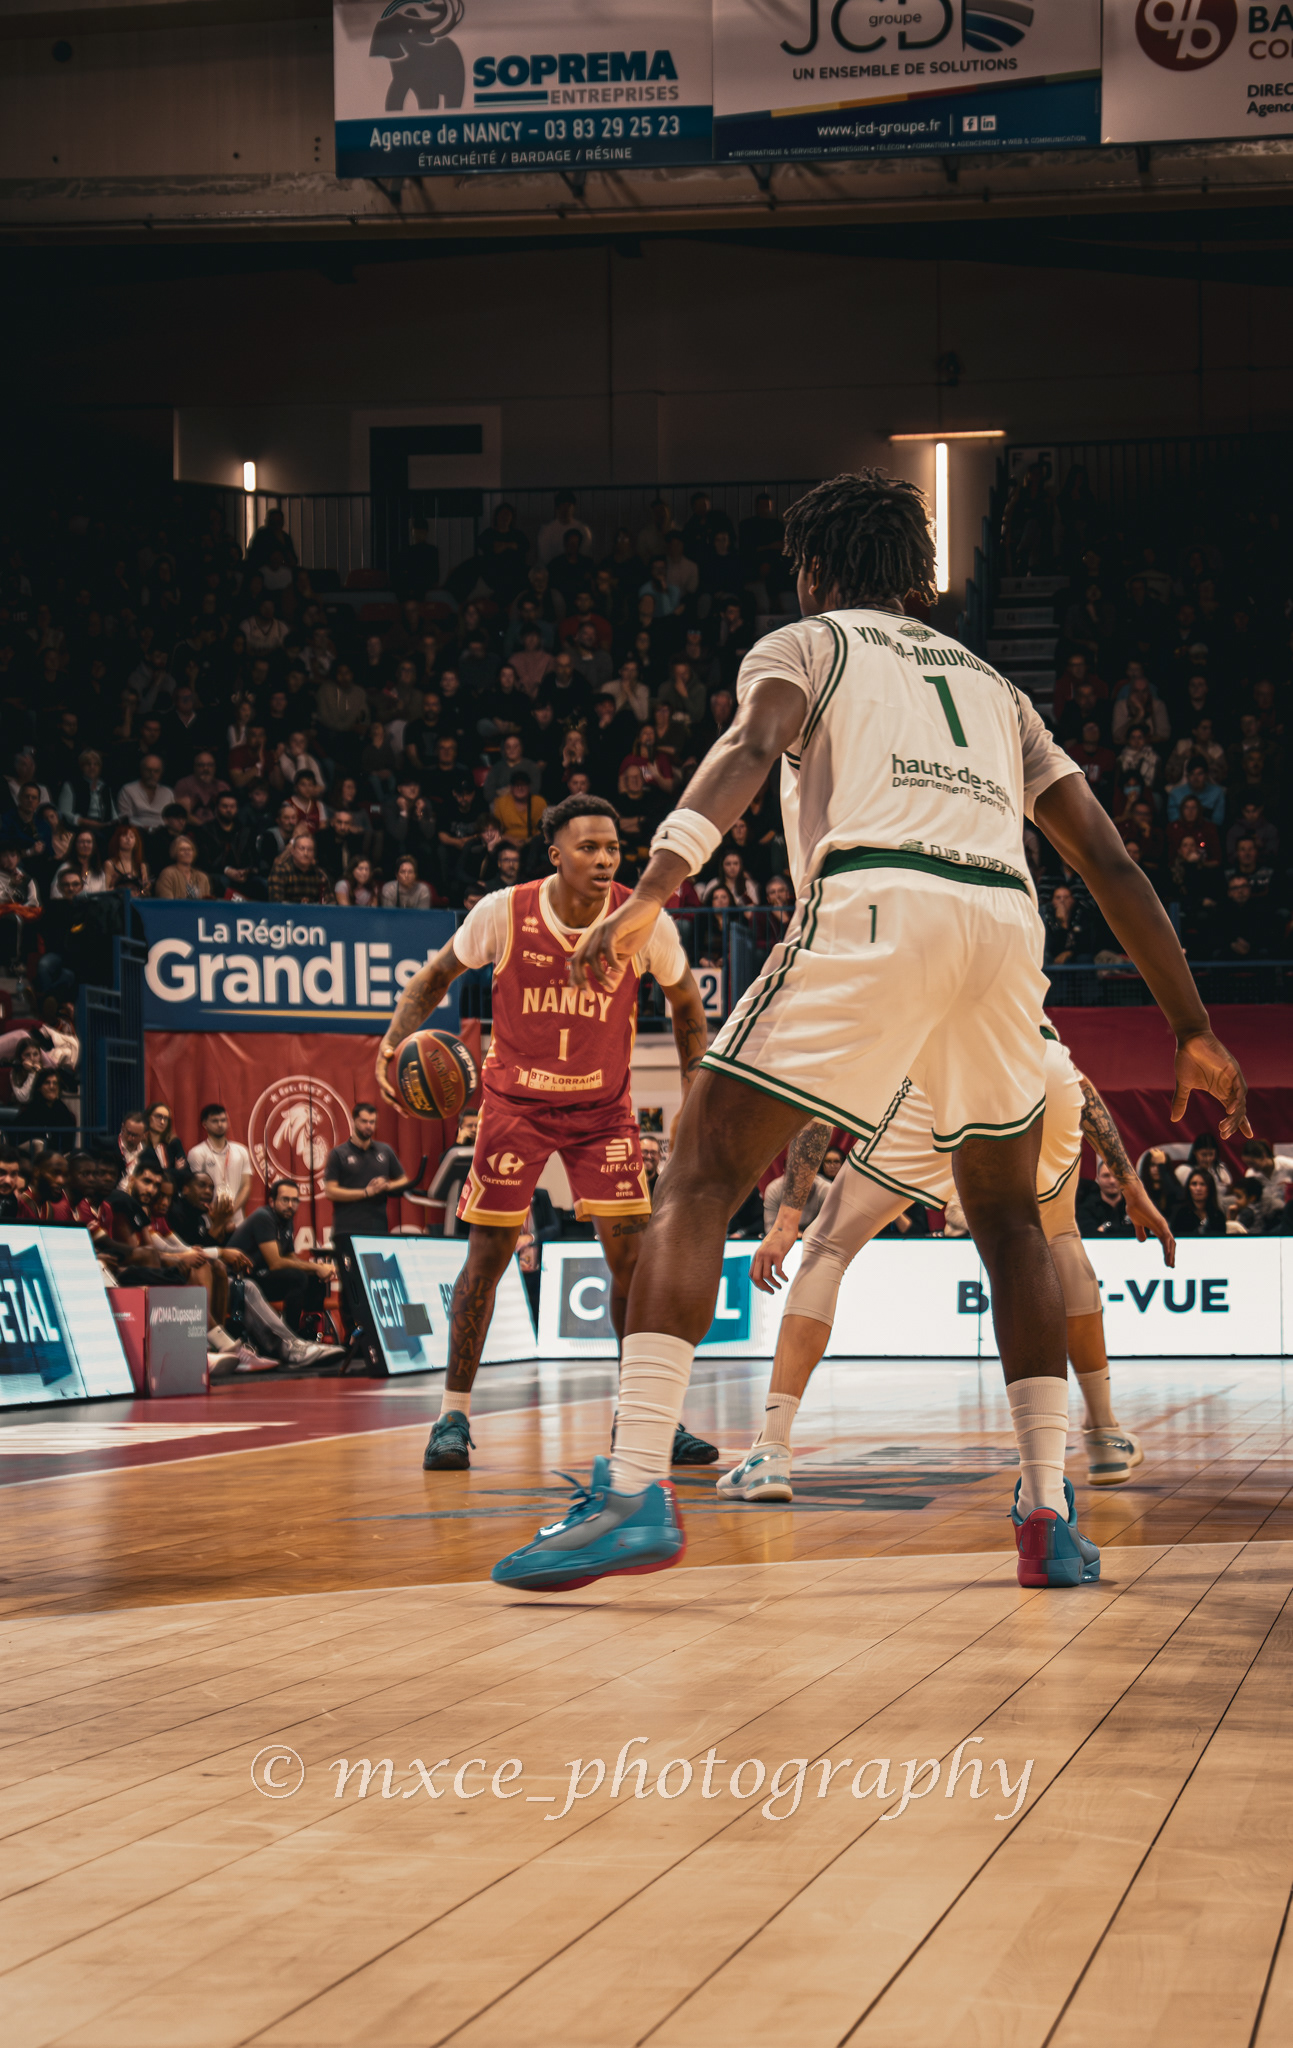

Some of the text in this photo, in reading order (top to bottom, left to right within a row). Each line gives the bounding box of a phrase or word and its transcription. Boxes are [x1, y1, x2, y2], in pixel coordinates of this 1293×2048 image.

[868, 12, 922, 28] groupe
[1249, 38, 1293, 60] CO
[473, 50, 679, 88] SOPREMA
[793, 57, 1018, 80] UN ENSEMBLE DE SOLUTIONS
[550, 85, 679, 105] ENTREPRISES
[369, 124, 434, 152] Agence
[437, 121, 457, 145] de
[463, 120, 523, 144] NANCY
[544, 119, 566, 141] 03
[573, 118, 595, 139] 83
[601, 117, 623, 138] 29
[630, 116, 652, 137] 25
[658, 115, 680, 136] 23
[817, 118, 941, 137] www.jcd-groupe.fr
[418, 150, 497, 168] ÉTANCHÉITÉ
[511, 149, 571, 164] BARDAGE
[585, 147, 632, 161] RÉSINE
[922, 675, 968, 748] 1
[891, 753, 1016, 820] hauts-de-sein
[930, 844, 960, 862] CLUB
[197, 917, 327, 950] La Région
[867, 904, 878, 943] 1
[144, 937, 348, 1006] Grand
[522, 986, 613, 1023] NANCY
[558, 1028, 570, 1062] 1
[530, 1071, 601, 1086] BTP LORRAINE
[481, 1174, 522, 1187] Carrefour
[600, 1162, 640, 1173] EIFFAGE
[0, 1275, 60, 1343] ETAL
[958, 1278, 1230, 1315] B-VUE
